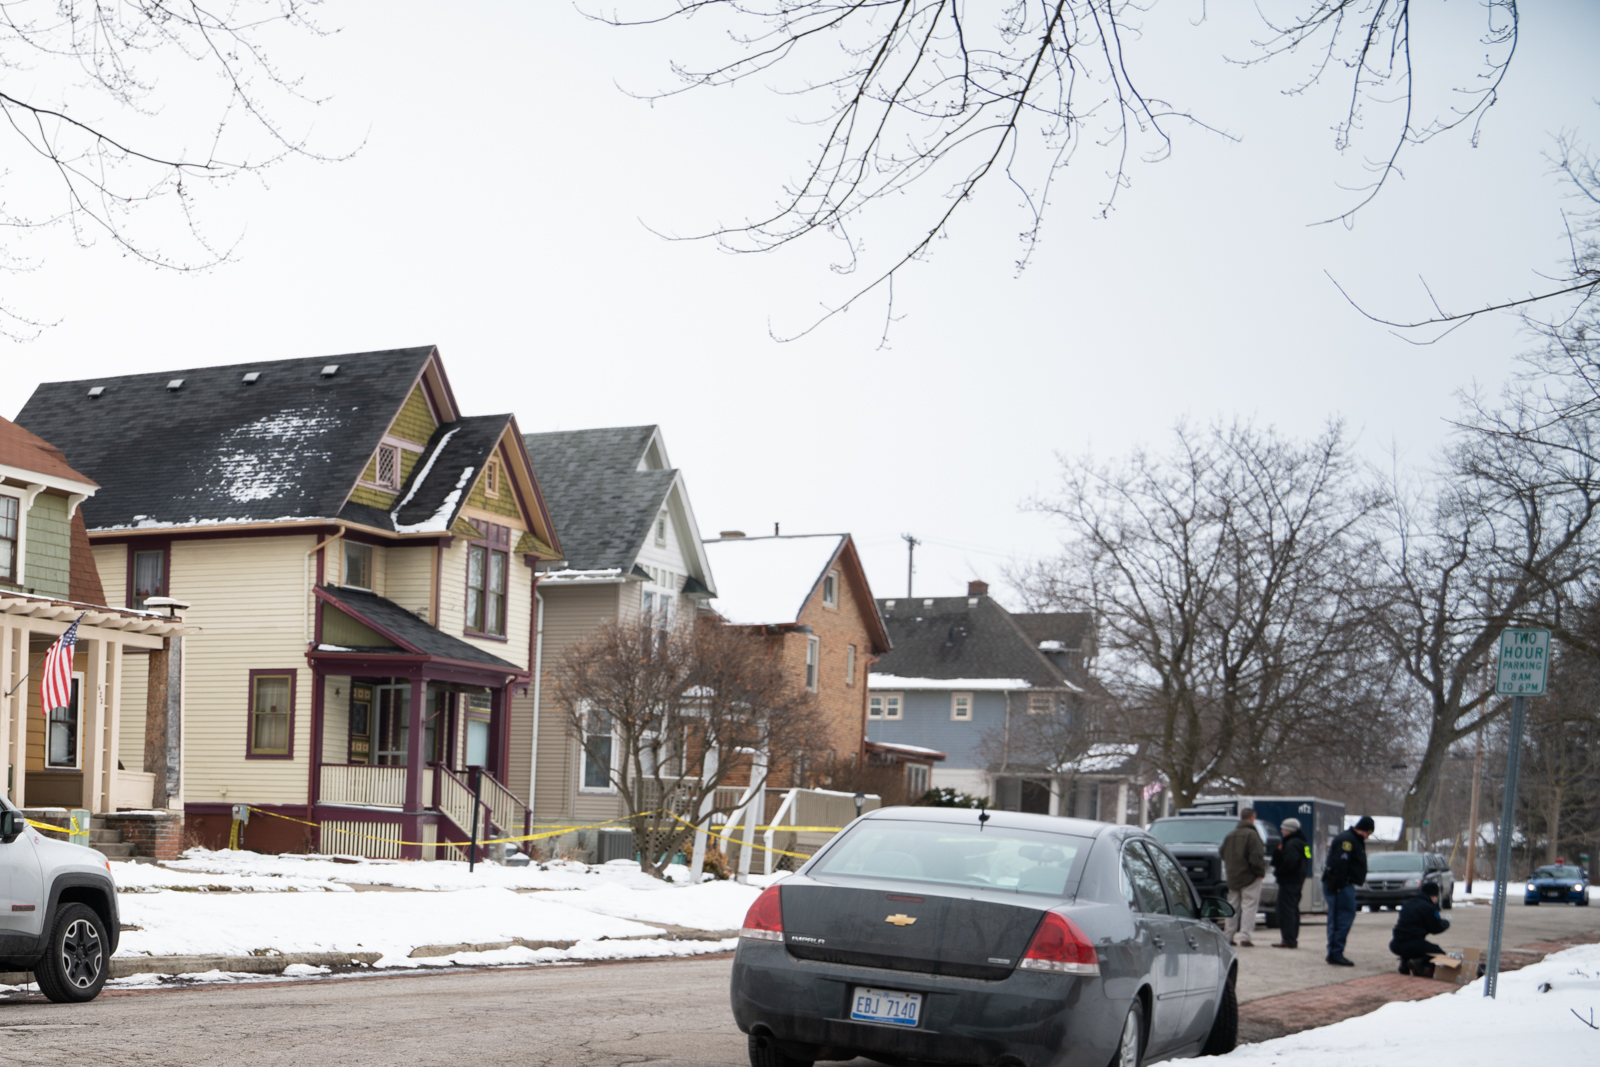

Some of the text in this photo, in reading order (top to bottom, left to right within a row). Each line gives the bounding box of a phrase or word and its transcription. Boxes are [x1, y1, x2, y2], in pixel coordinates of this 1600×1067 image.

[1513, 632, 1537, 644] TWO
[1504, 646, 1543, 659] HOUR
[1502, 661, 1542, 670] PARKING
[856, 996, 917, 1019] EBJ 7140
